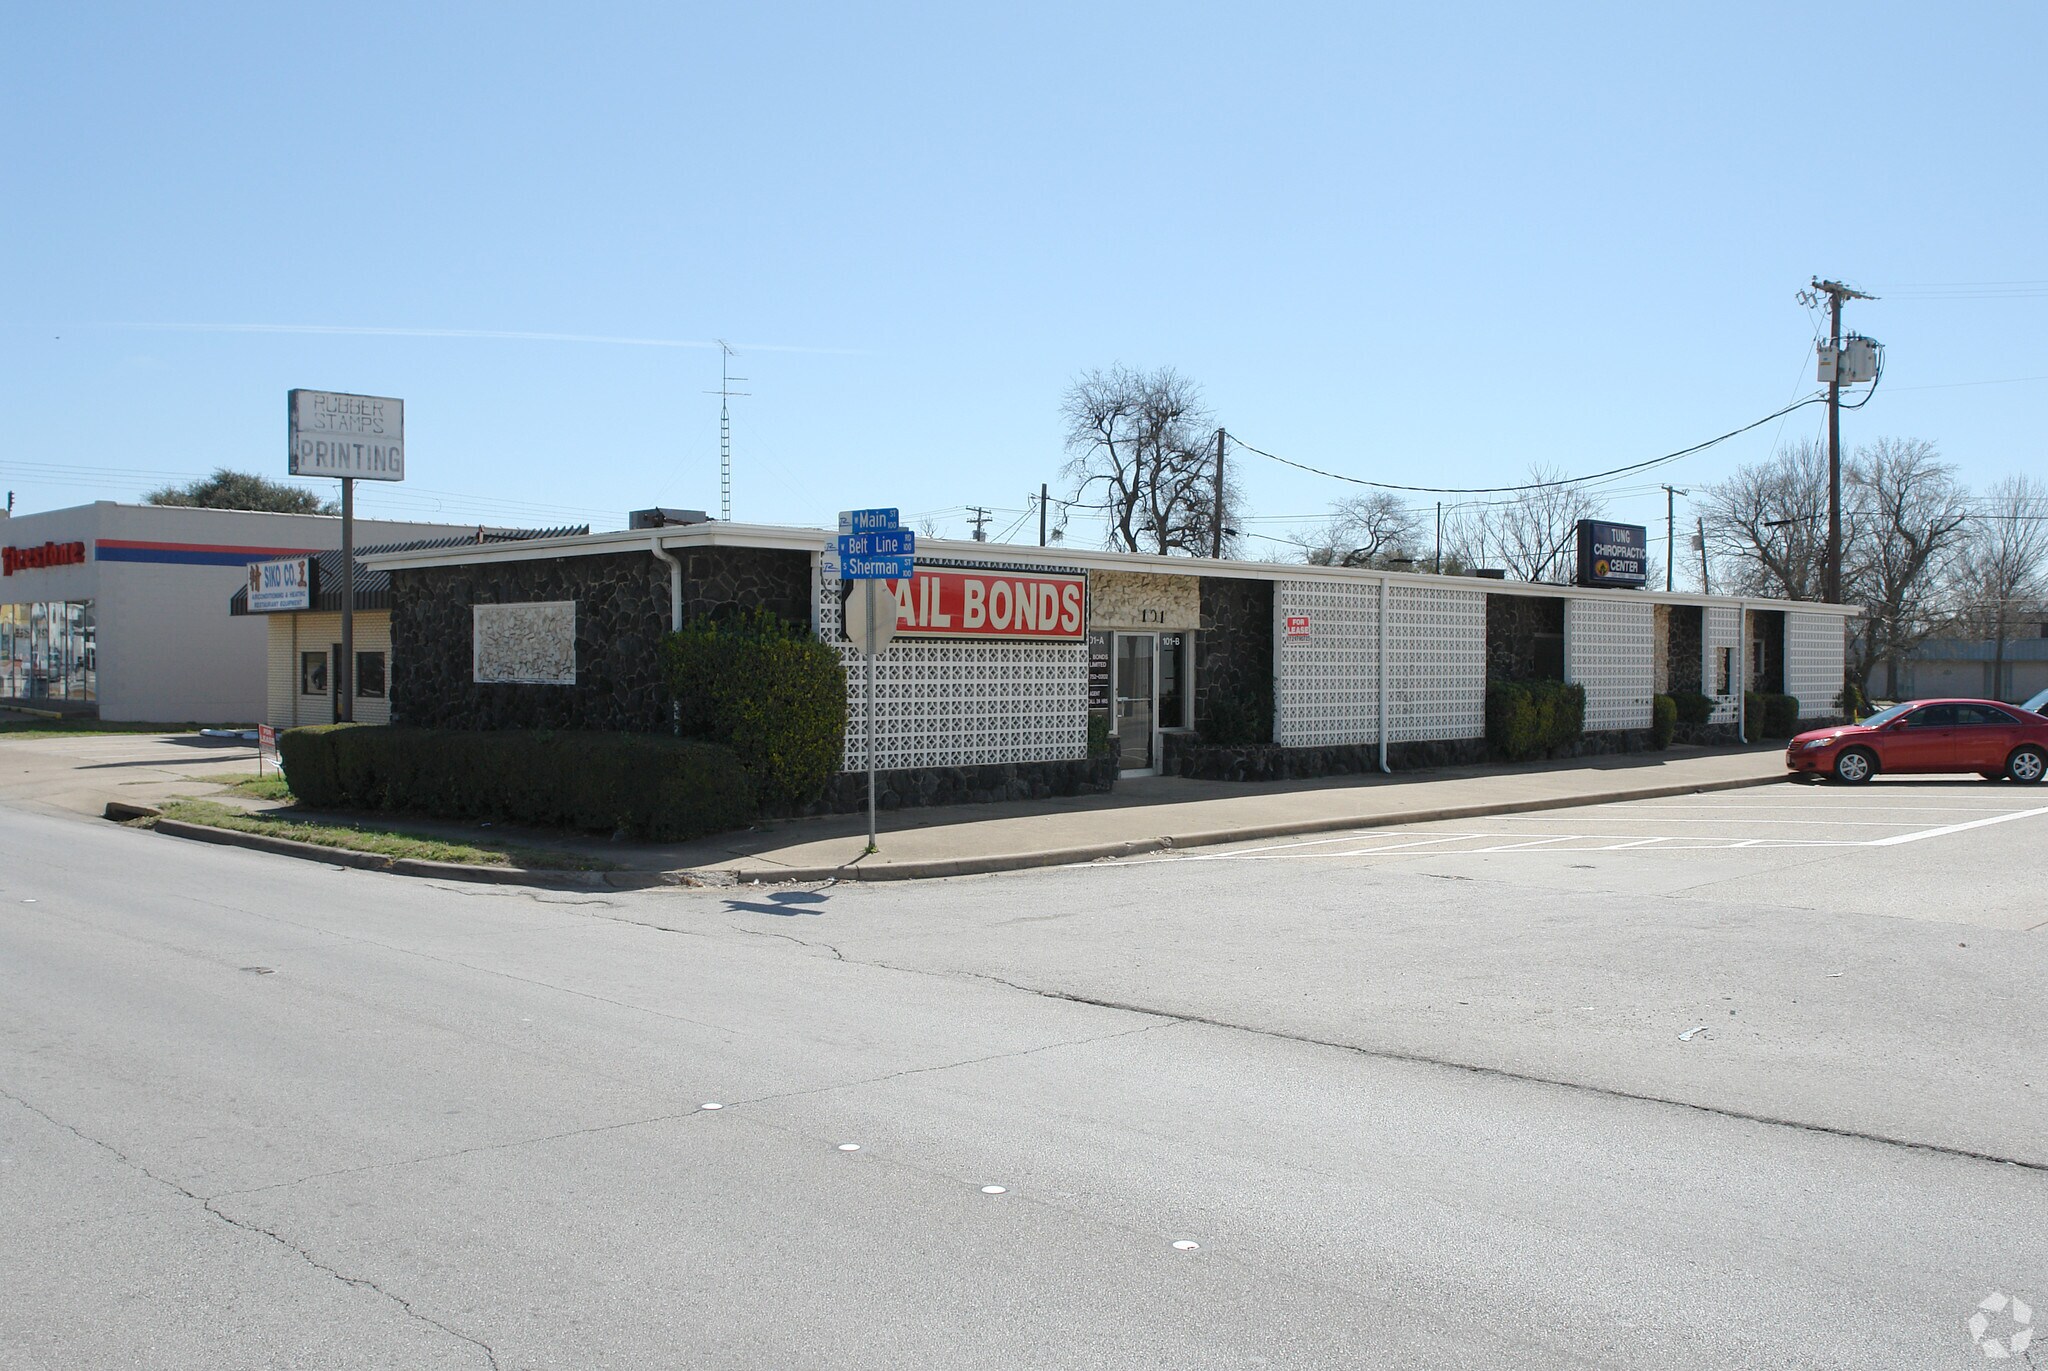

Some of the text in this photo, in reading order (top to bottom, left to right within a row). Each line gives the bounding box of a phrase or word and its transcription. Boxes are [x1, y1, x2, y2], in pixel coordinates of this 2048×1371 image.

[314, 395, 384, 417] RUBBER
[314, 413, 384, 434] STAMPS
[301, 440, 400, 472] PRINTING
[860, 512, 887, 528] Main
[889, 510, 897, 518] ST
[887, 521, 897, 529] 100
[1611, 528, 1630, 543] TUNG
[849, 537, 868, 554] Belt
[876, 536, 898, 553] Line
[904, 534, 912, 542] RD
[903, 543, 912, 551] 100
[1594, 543, 1646, 560] CHIROPRACTIC
[843, 558, 911, 575] S Sherman ST
[902, 569, 911, 577] 100
[1610, 559, 1638, 573] CENTER
[264, 563, 297, 588] SIKO CO.
[896, 577, 1080, 632] AIL BONDS
[1142, 609, 1164, 623] 101
[1292, 618, 1305, 626] FOR
[1287, 626, 1310, 635] LEASE
[1090, 636, 1104, 644] 01-A
[1162, 637, 1180, 646] 101-B
